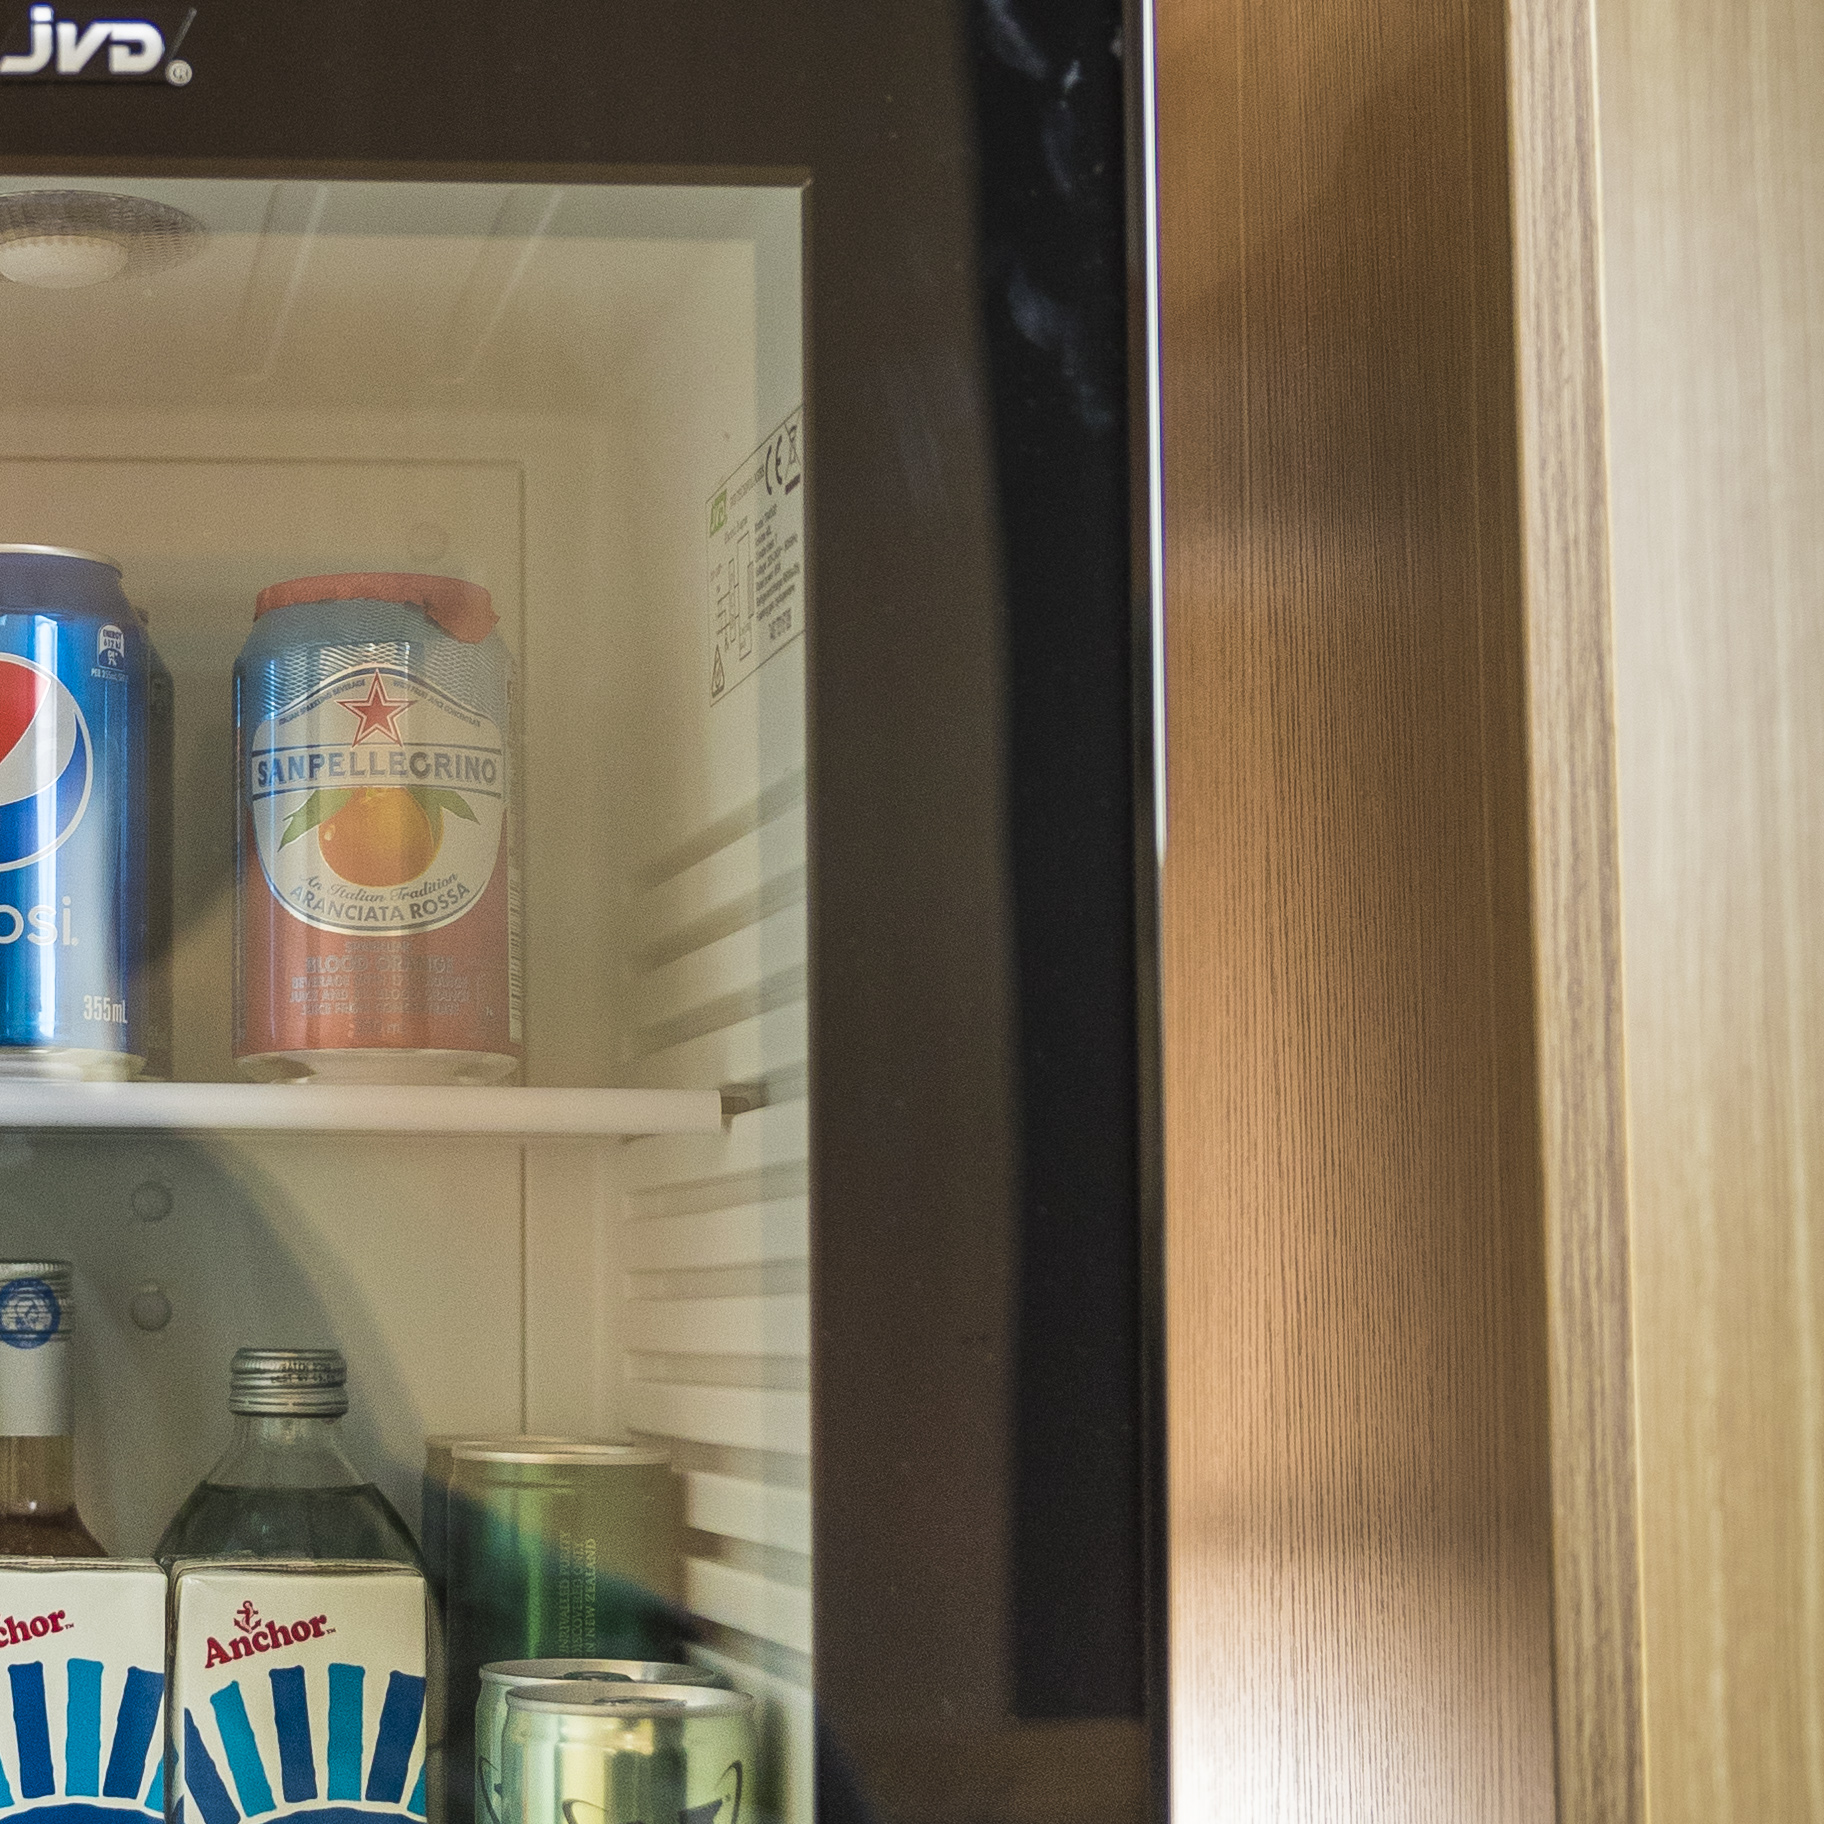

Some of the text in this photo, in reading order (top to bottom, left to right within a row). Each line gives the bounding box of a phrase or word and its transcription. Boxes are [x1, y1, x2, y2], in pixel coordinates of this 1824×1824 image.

[256, 750, 497, 788] SANPELLEGRINO
[290, 882, 471, 922] ARANCIATA ROSSA
[303, 872, 458, 903] An Italian Tradition
[83, 994, 128, 1025] 355mL
[584, 1537, 596, 1603] ZEALAND
[204, 1614, 327, 1669] Anchor
